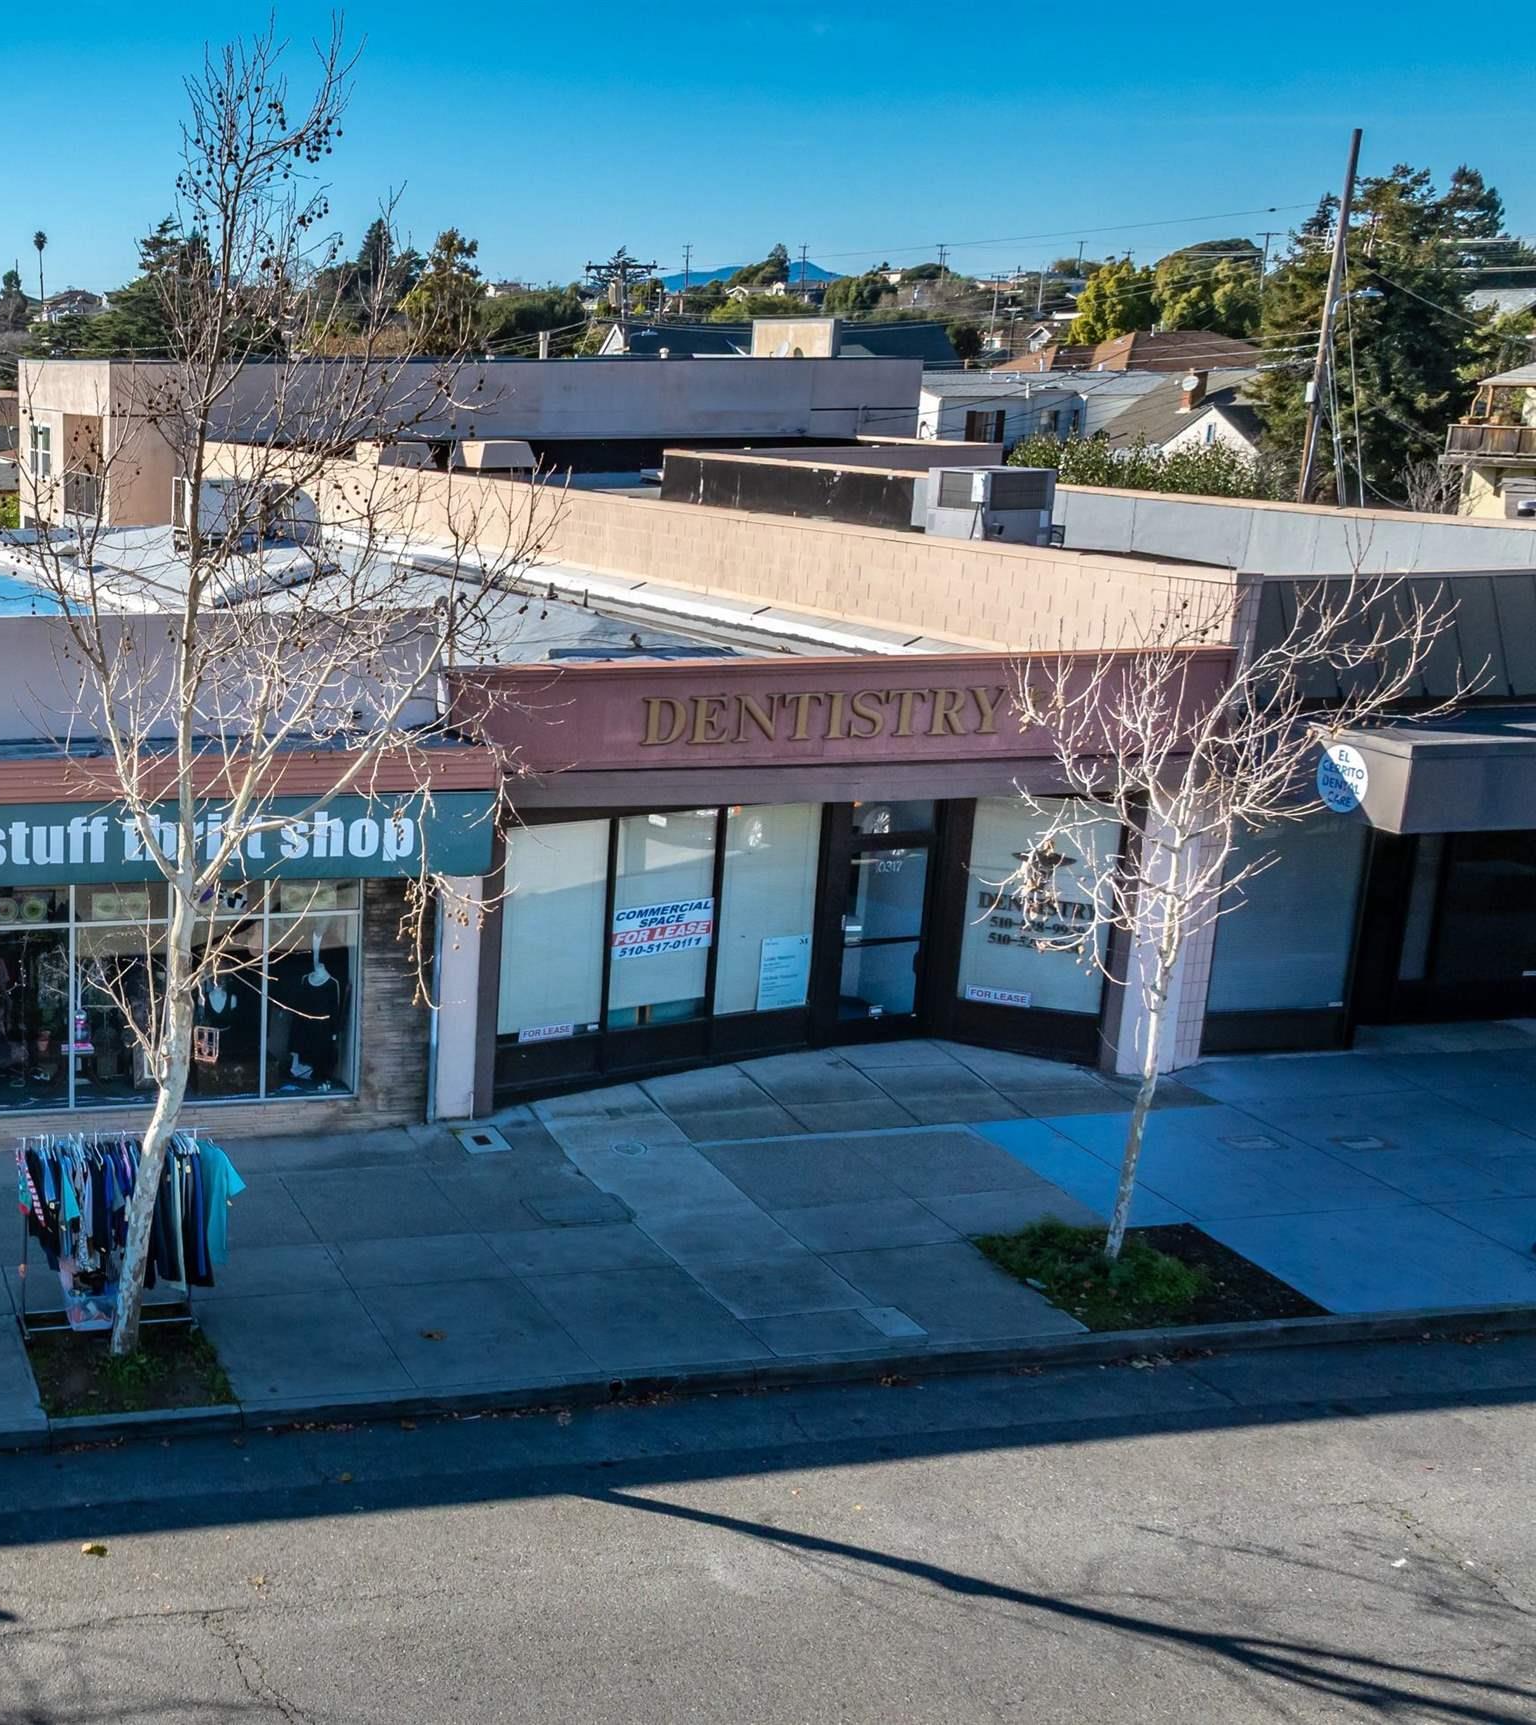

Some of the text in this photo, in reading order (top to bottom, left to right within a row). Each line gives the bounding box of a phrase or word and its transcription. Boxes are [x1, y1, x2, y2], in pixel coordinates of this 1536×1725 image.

[640, 686, 1007, 747] DENTISTRY
[1338, 749, 1351, 763] EL
[1322, 759, 1365, 780] CERRITO
[1327, 790, 1353, 808] CARE
[122, 813, 265, 861] thrit
[280, 811, 415, 862] shop
[616, 901, 711, 921] COMMERCIAL
[639, 913, 685, 928] SPACE
[614, 921, 709, 945] FOR LEASE
[619, 937, 702, 957] 510-517-0111
[970, 988, 1027, 1003] FOR LEASE
[522, 1024, 571, 1038] FOR LEASE
